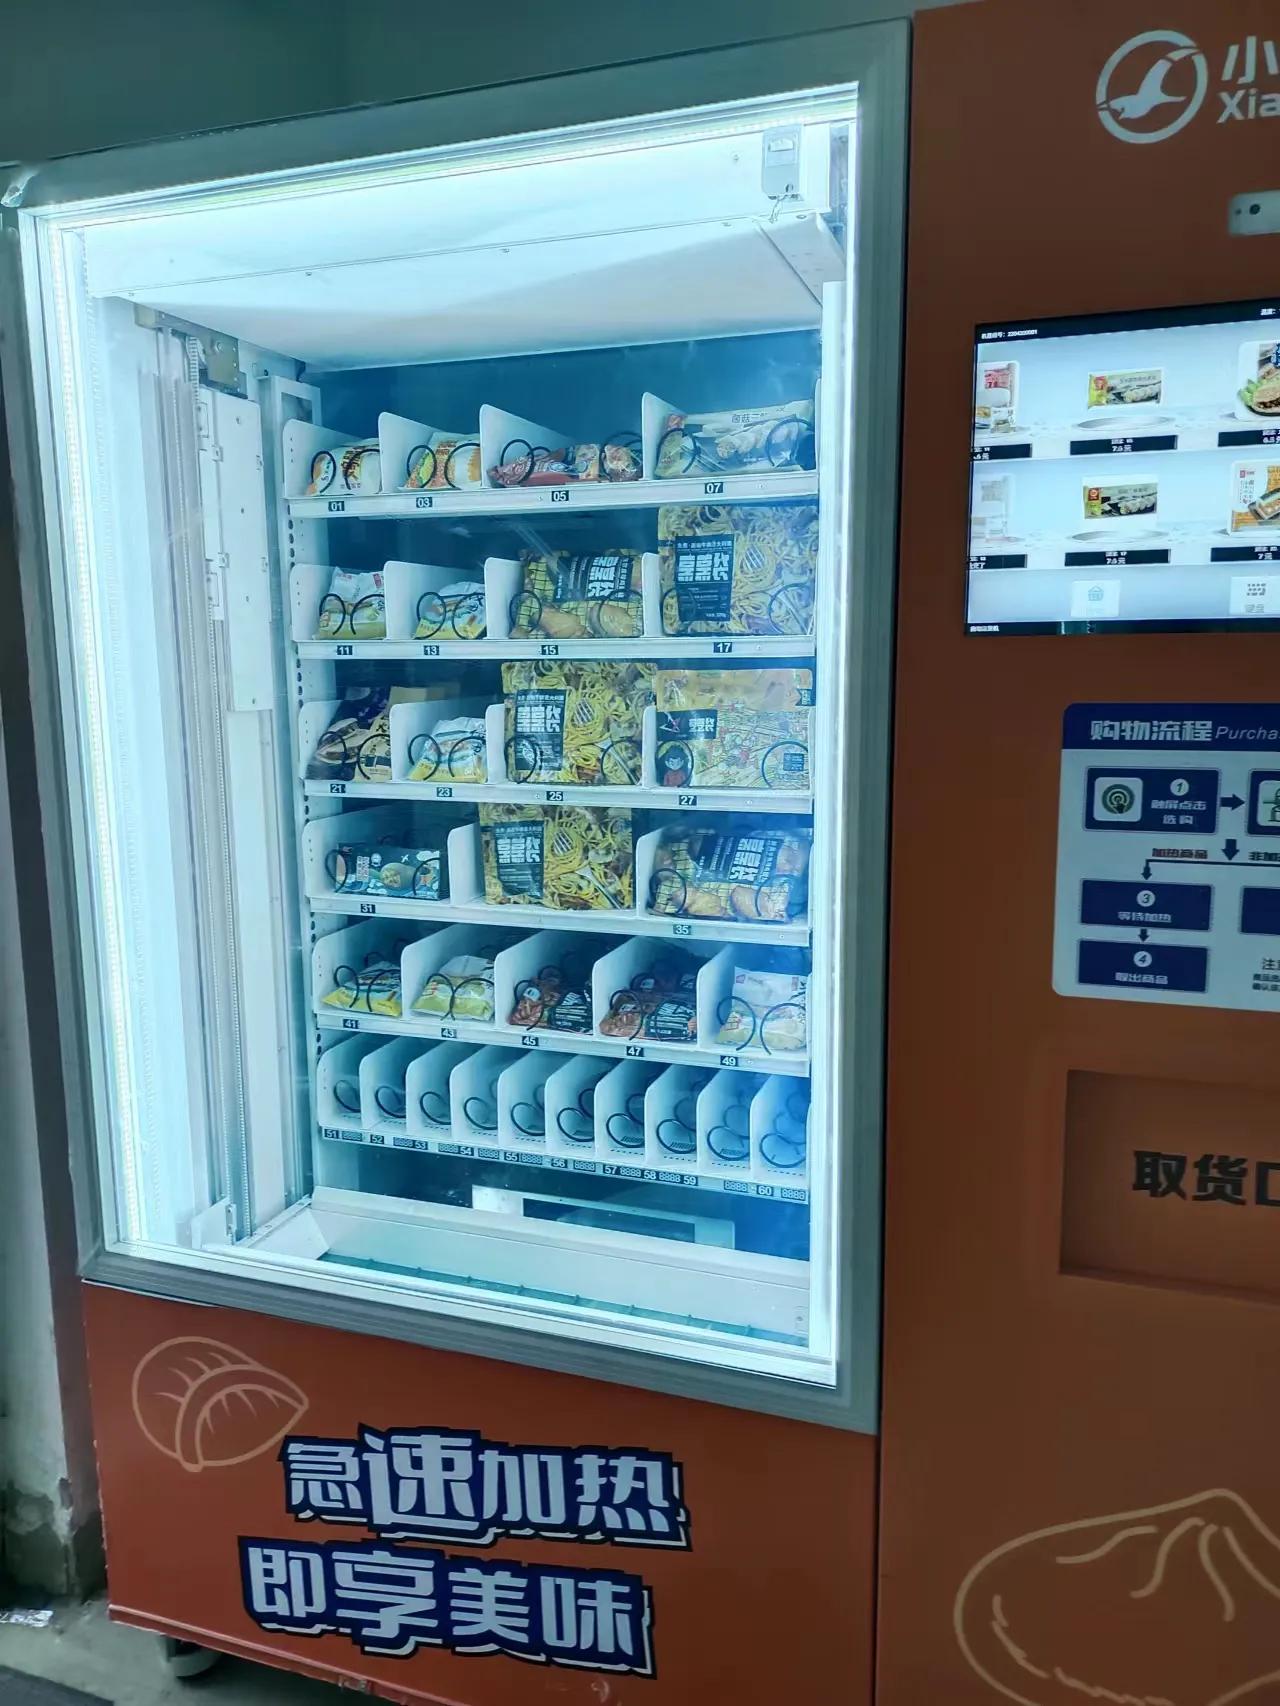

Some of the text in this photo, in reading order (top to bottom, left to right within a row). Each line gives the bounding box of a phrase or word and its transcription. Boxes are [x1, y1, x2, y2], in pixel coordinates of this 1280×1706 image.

[706, 482, 722, 494] 07
[552, 490, 568, 501] 05
[330, 502, 344, 512] 01
[417, 497, 431, 508] 03
[425, 646, 439, 655] 13
[542, 645, 557, 655] 15
[716, 642, 732, 653] 17
[1090, 719, 1280, 742] 购物流程 Purcha
[331, 784, 345, 793] 21
[438, 787, 451, 797] 23
[549, 790, 563, 801] 25
[680, 795, 695, 806] 27
[1152, 847, 1208, 860] 加热商品
[361, 904, 374, 913] 31
[1117, 910, 1172, 923] 等待加热
[675, 924, 690, 935] 35
[1114, 971, 1169, 985] 取出商品
[344, 1019, 358, 1029] 41
[442, 1028, 456, 1038] 43
[523, 1036, 537, 1046] 45
[627, 1046, 642, 1056] 47
[721, 1056, 737, 1067] 49
[326, 1129, 338, 1139] 51
[371, 1135, 384, 1144] 52
[415, 1141, 428, 1150] 53
[459, 1146, 473, 1156] 54
[505, 1152, 518, 1161] 55
[552, 1158, 566, 1168] 56
[604, 1165, 617, 1175] 57
[643, 1170, 657, 1180] 58
[683, 1175, 697, 1185] 59
[757, 1185, 773, 1196] 60
[286, 1432, 671, 1534] 急速加热
[247, 1546, 635, 1657] 即享美味
